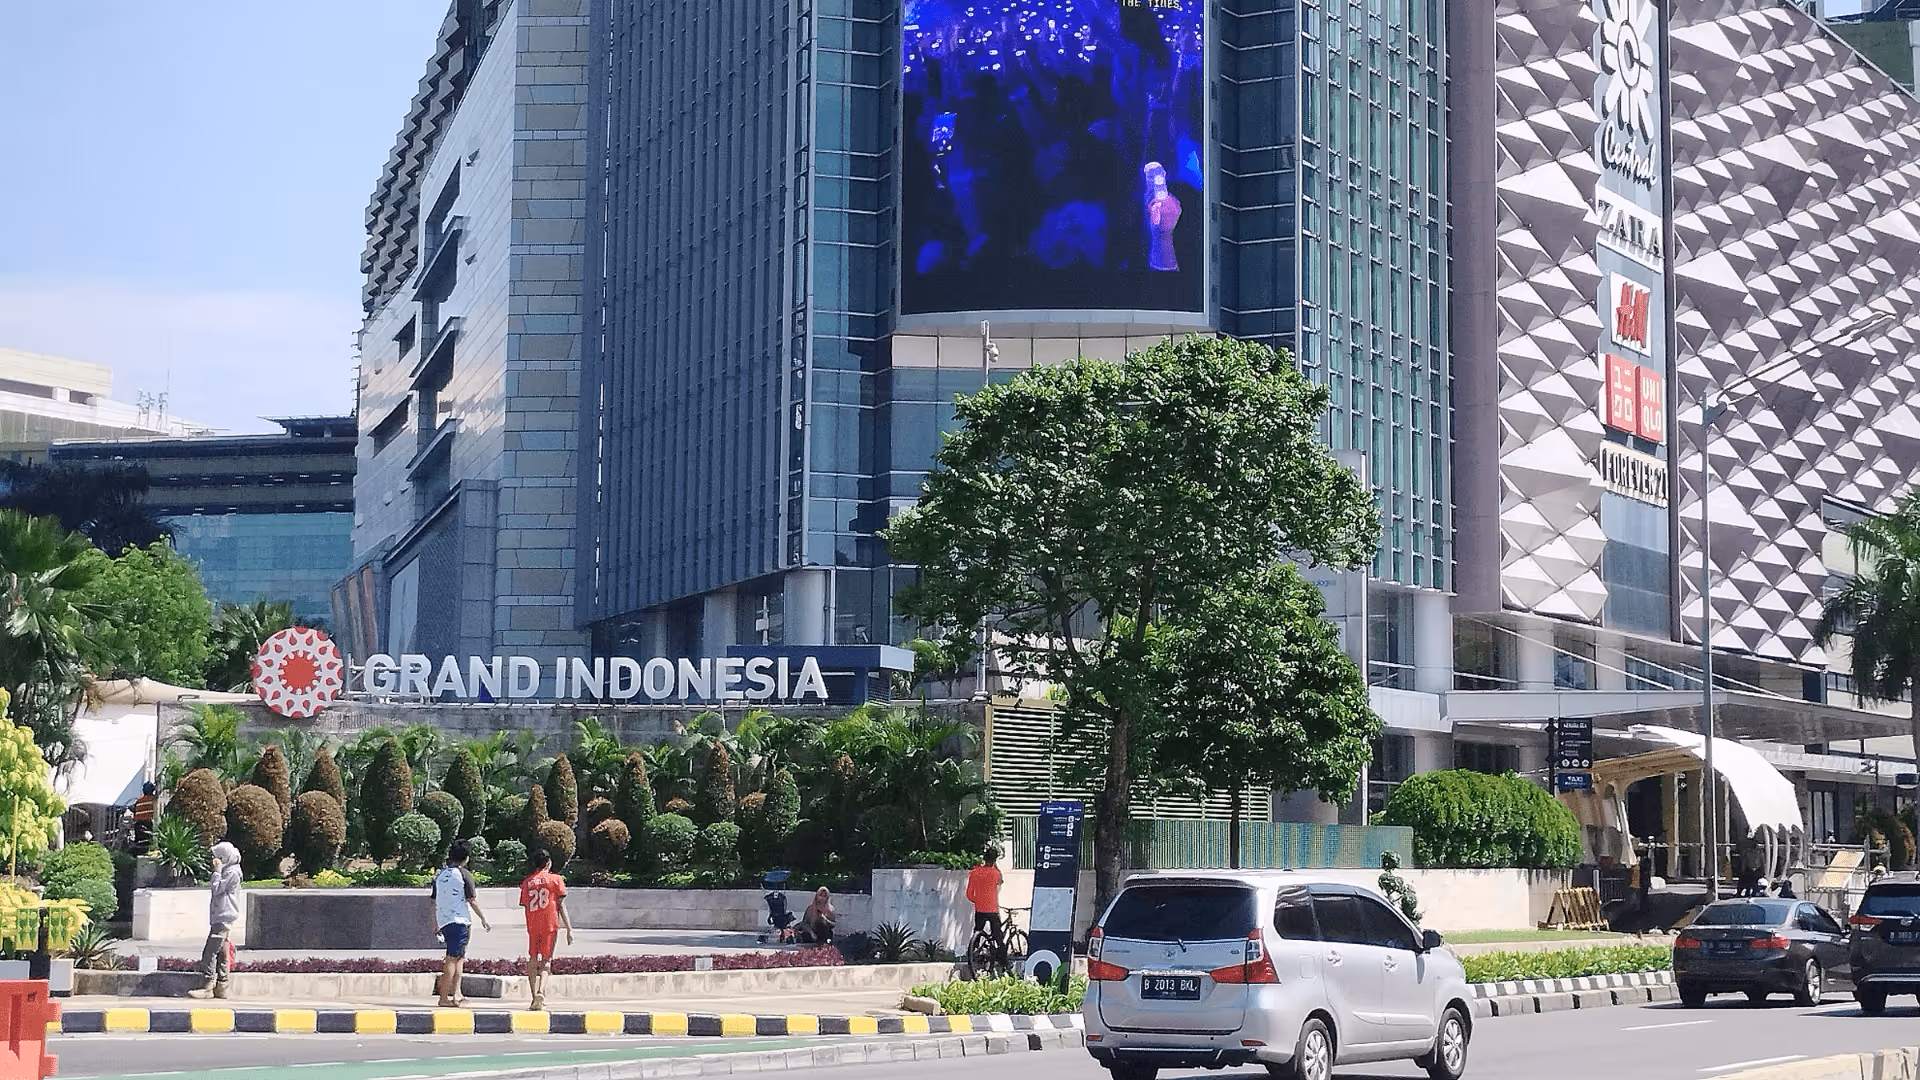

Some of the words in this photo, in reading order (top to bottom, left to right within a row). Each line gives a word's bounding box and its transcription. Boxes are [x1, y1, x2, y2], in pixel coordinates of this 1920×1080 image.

[1602, 120, 1657, 187] Central
[1598, 199, 1662, 254] ZARA
[1642, 375, 1661, 405] UNI
[1643, 404, 1662, 433] QLO
[363, 654, 541, 699] GRAND
[555, 656, 829, 700] INDONESIA
[529, 888, 549, 912] 28
[1144, 978, 1150, 991] B
[1154, 978, 1175, 991] 2013
